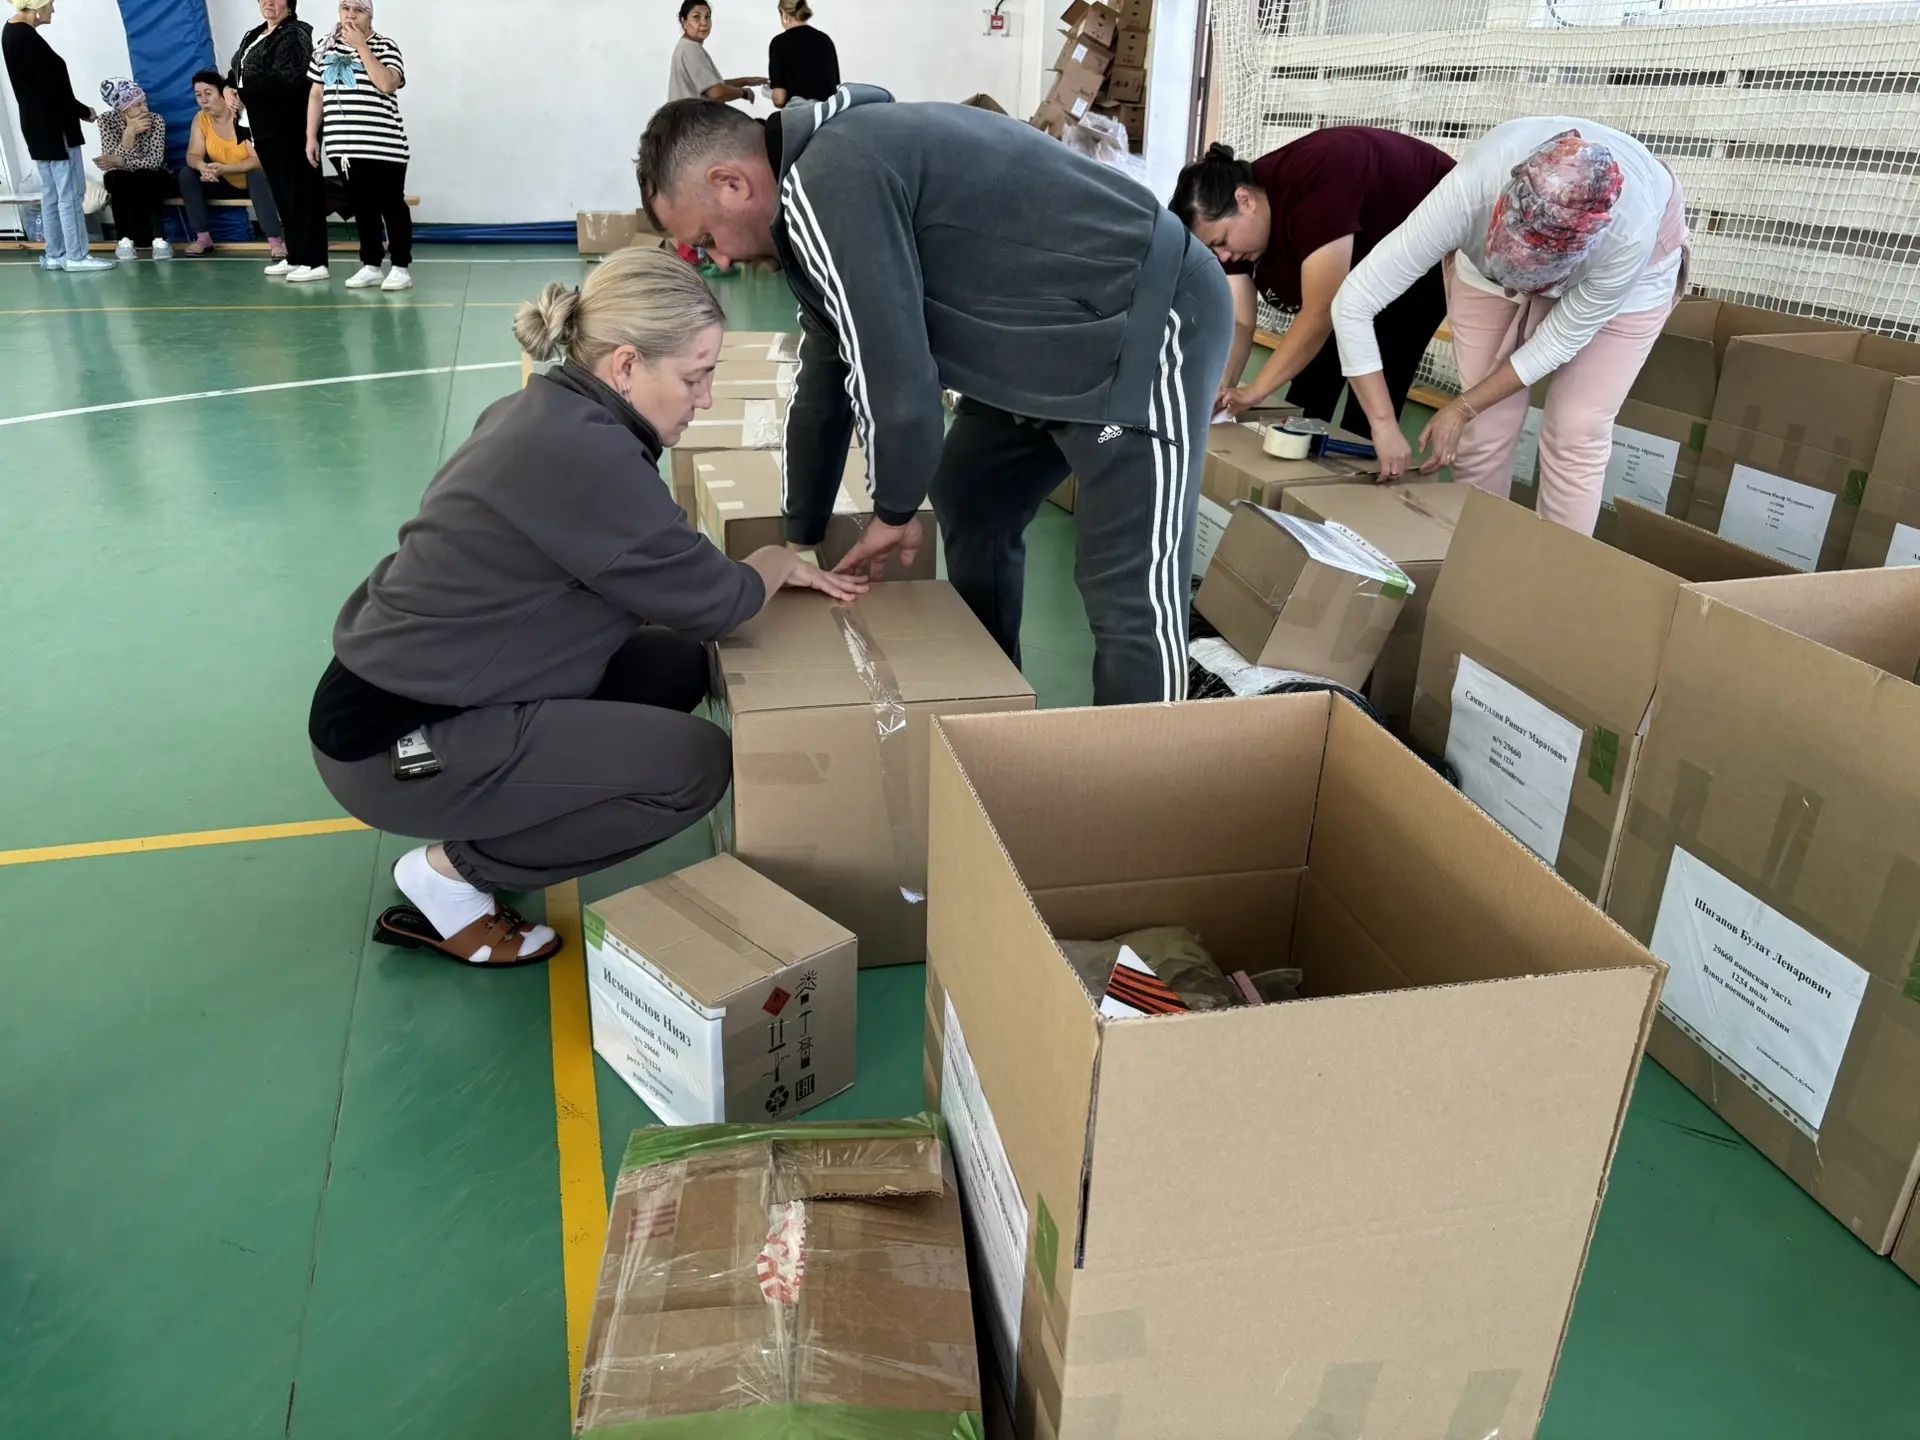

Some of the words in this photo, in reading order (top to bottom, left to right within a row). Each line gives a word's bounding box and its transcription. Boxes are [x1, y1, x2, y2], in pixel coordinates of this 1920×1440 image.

[1465, 690, 1504, 722] Самигуллин
[1504, 716, 1528, 736] Ришат
[1528, 730, 1568, 764] Маратович
[1492, 736, 1502, 746] в/ч
[1503, 741, 1522, 759] 29660
[1503, 756, 1514, 767] 1234
[1694, 898, 1738, 934] Шигапов
[1740, 929, 1771, 957] Булат
[1772, 952, 1832, 999] Ленарович
[1712, 944, 1734, 963] 29660
[1734, 960, 1769, 989] воинская
[1771, 986, 1792, 1006] часть
[602, 968, 661, 1023] Исмагилов
[664, 1015, 692, 1047] Нияз
[1703, 964, 1724, 986] Взвод
[1724, 981, 1755, 1008] военной
[1756, 1005, 1790, 1034] полиции
[1731, 972, 1748, 988] 1234
[1749, 986, 1768, 1003] полк
[620, 1006, 655, 1040] позывной
